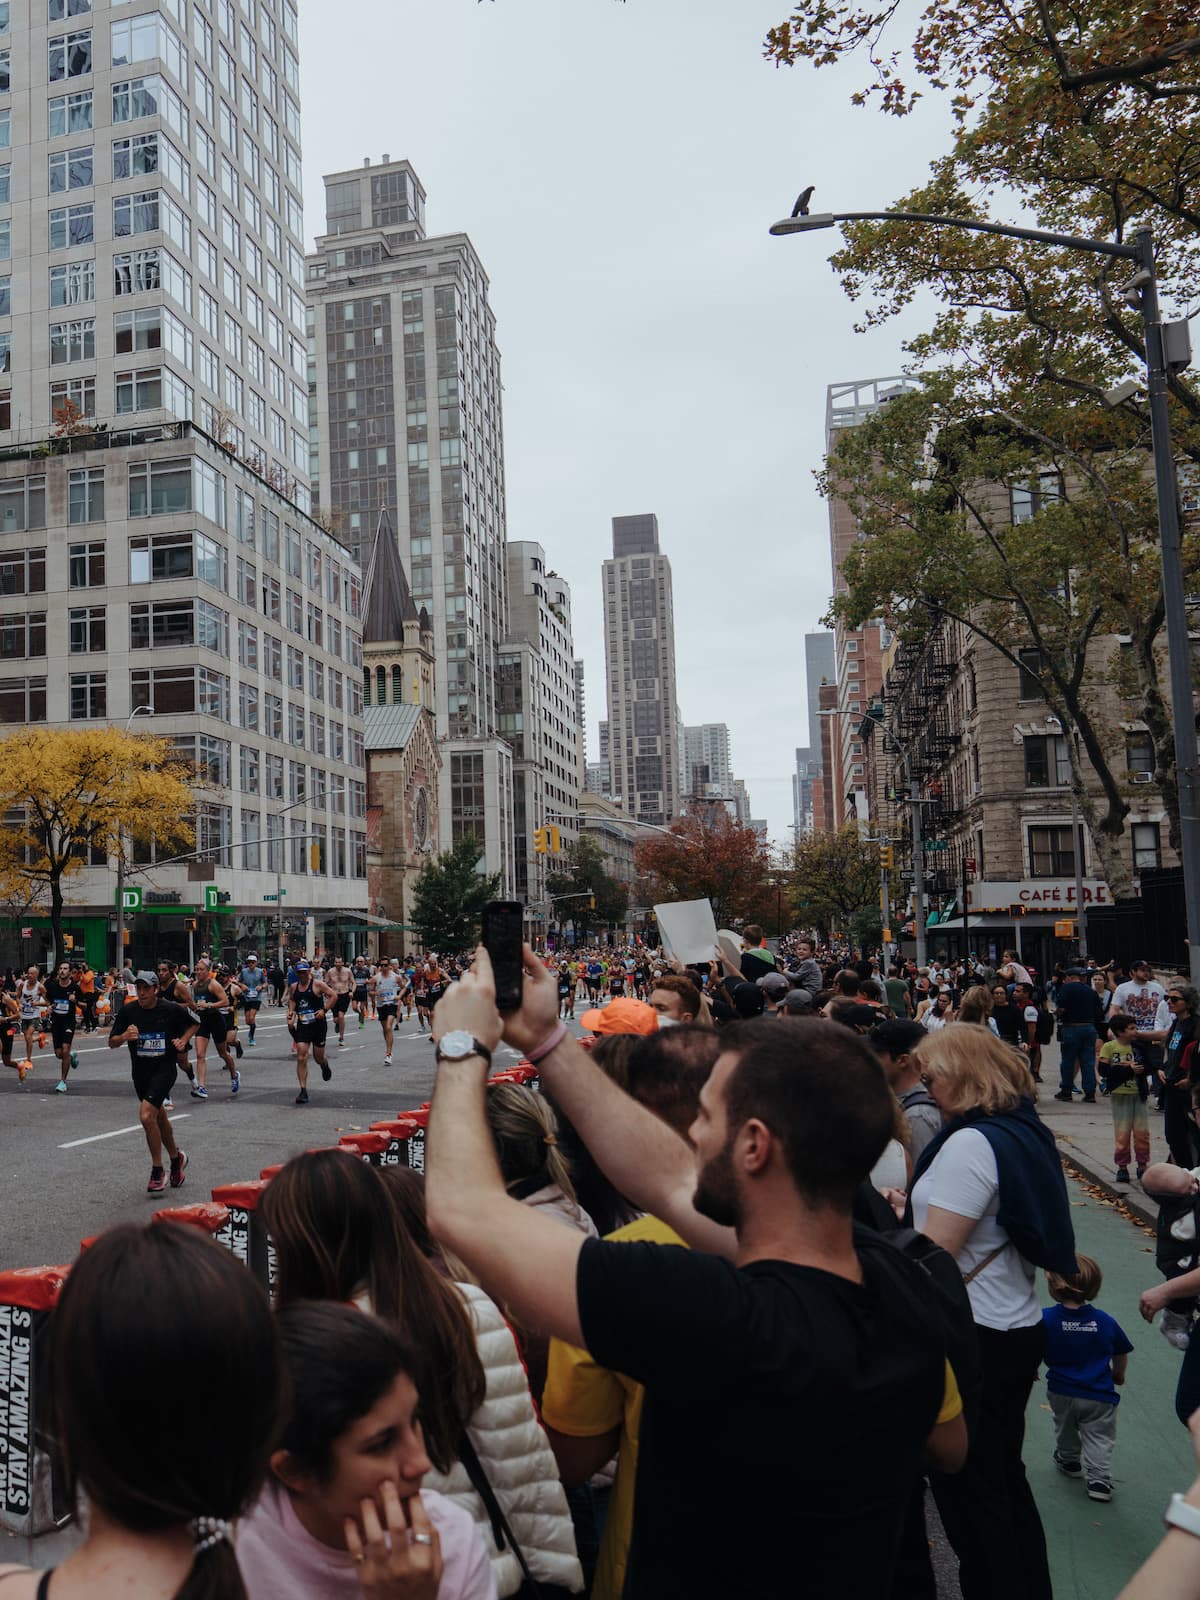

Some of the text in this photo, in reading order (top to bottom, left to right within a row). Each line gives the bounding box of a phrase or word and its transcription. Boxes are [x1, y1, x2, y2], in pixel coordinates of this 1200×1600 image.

[1020, 887, 1061, 901] CAFÉ
[9, 1336, 31, 1447] AMAZING
[7, 1444, 28, 1507] STAY
